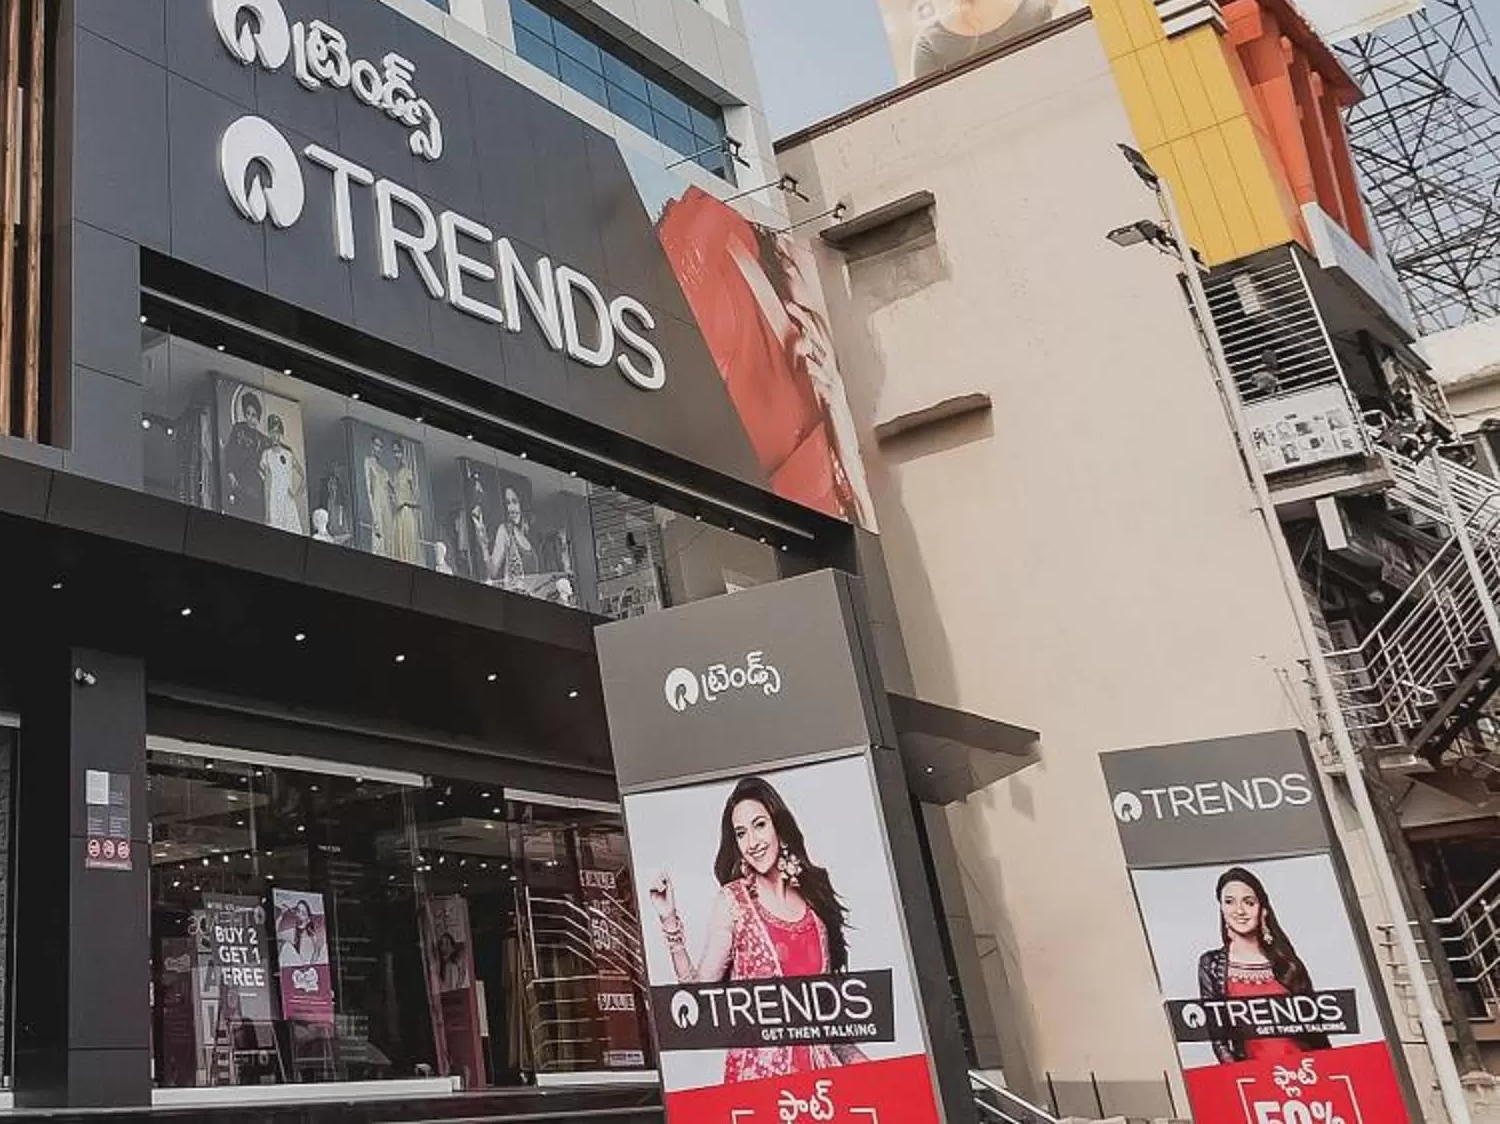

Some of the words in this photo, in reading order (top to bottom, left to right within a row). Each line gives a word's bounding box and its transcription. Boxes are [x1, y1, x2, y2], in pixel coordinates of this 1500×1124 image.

[303, 143, 666, 391] TRENDS
[1141, 773, 1313, 819] TRENDS
[215, 926, 243, 943] BUY
[247, 928, 259, 944] 2
[219, 945, 248, 964] GET
[252, 947, 261, 964] 1
[222, 967, 265, 987] FREE
[699, 978, 873, 1027] TRENDS
[1204, 994, 1343, 1027] TRENDS
[761, 1028, 784, 1041] GET
[787, 1026, 820, 1039] THEM
[823, 1023, 877, 1037] TALKING
